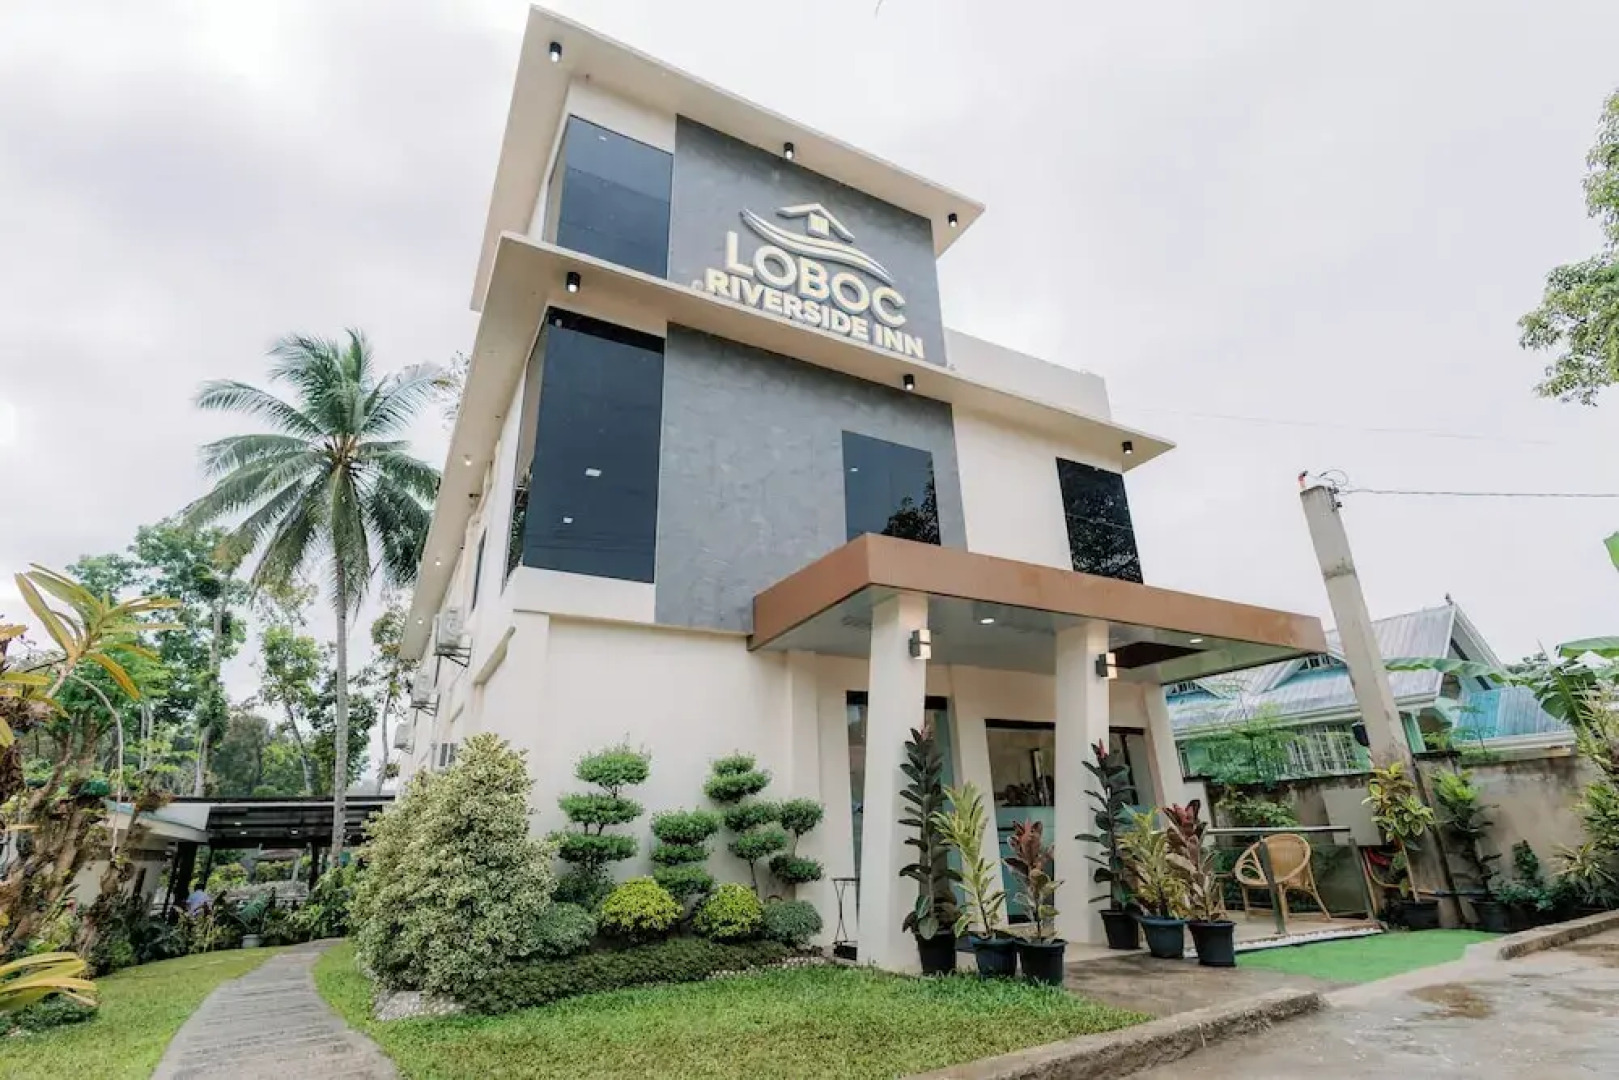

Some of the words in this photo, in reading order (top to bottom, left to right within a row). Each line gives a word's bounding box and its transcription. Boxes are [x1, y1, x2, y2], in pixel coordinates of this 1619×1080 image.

[704, 267, 868, 340] RIVERSIDE
[874, 323, 924, 359] INN
[724, 231, 906, 327] LOBOC
